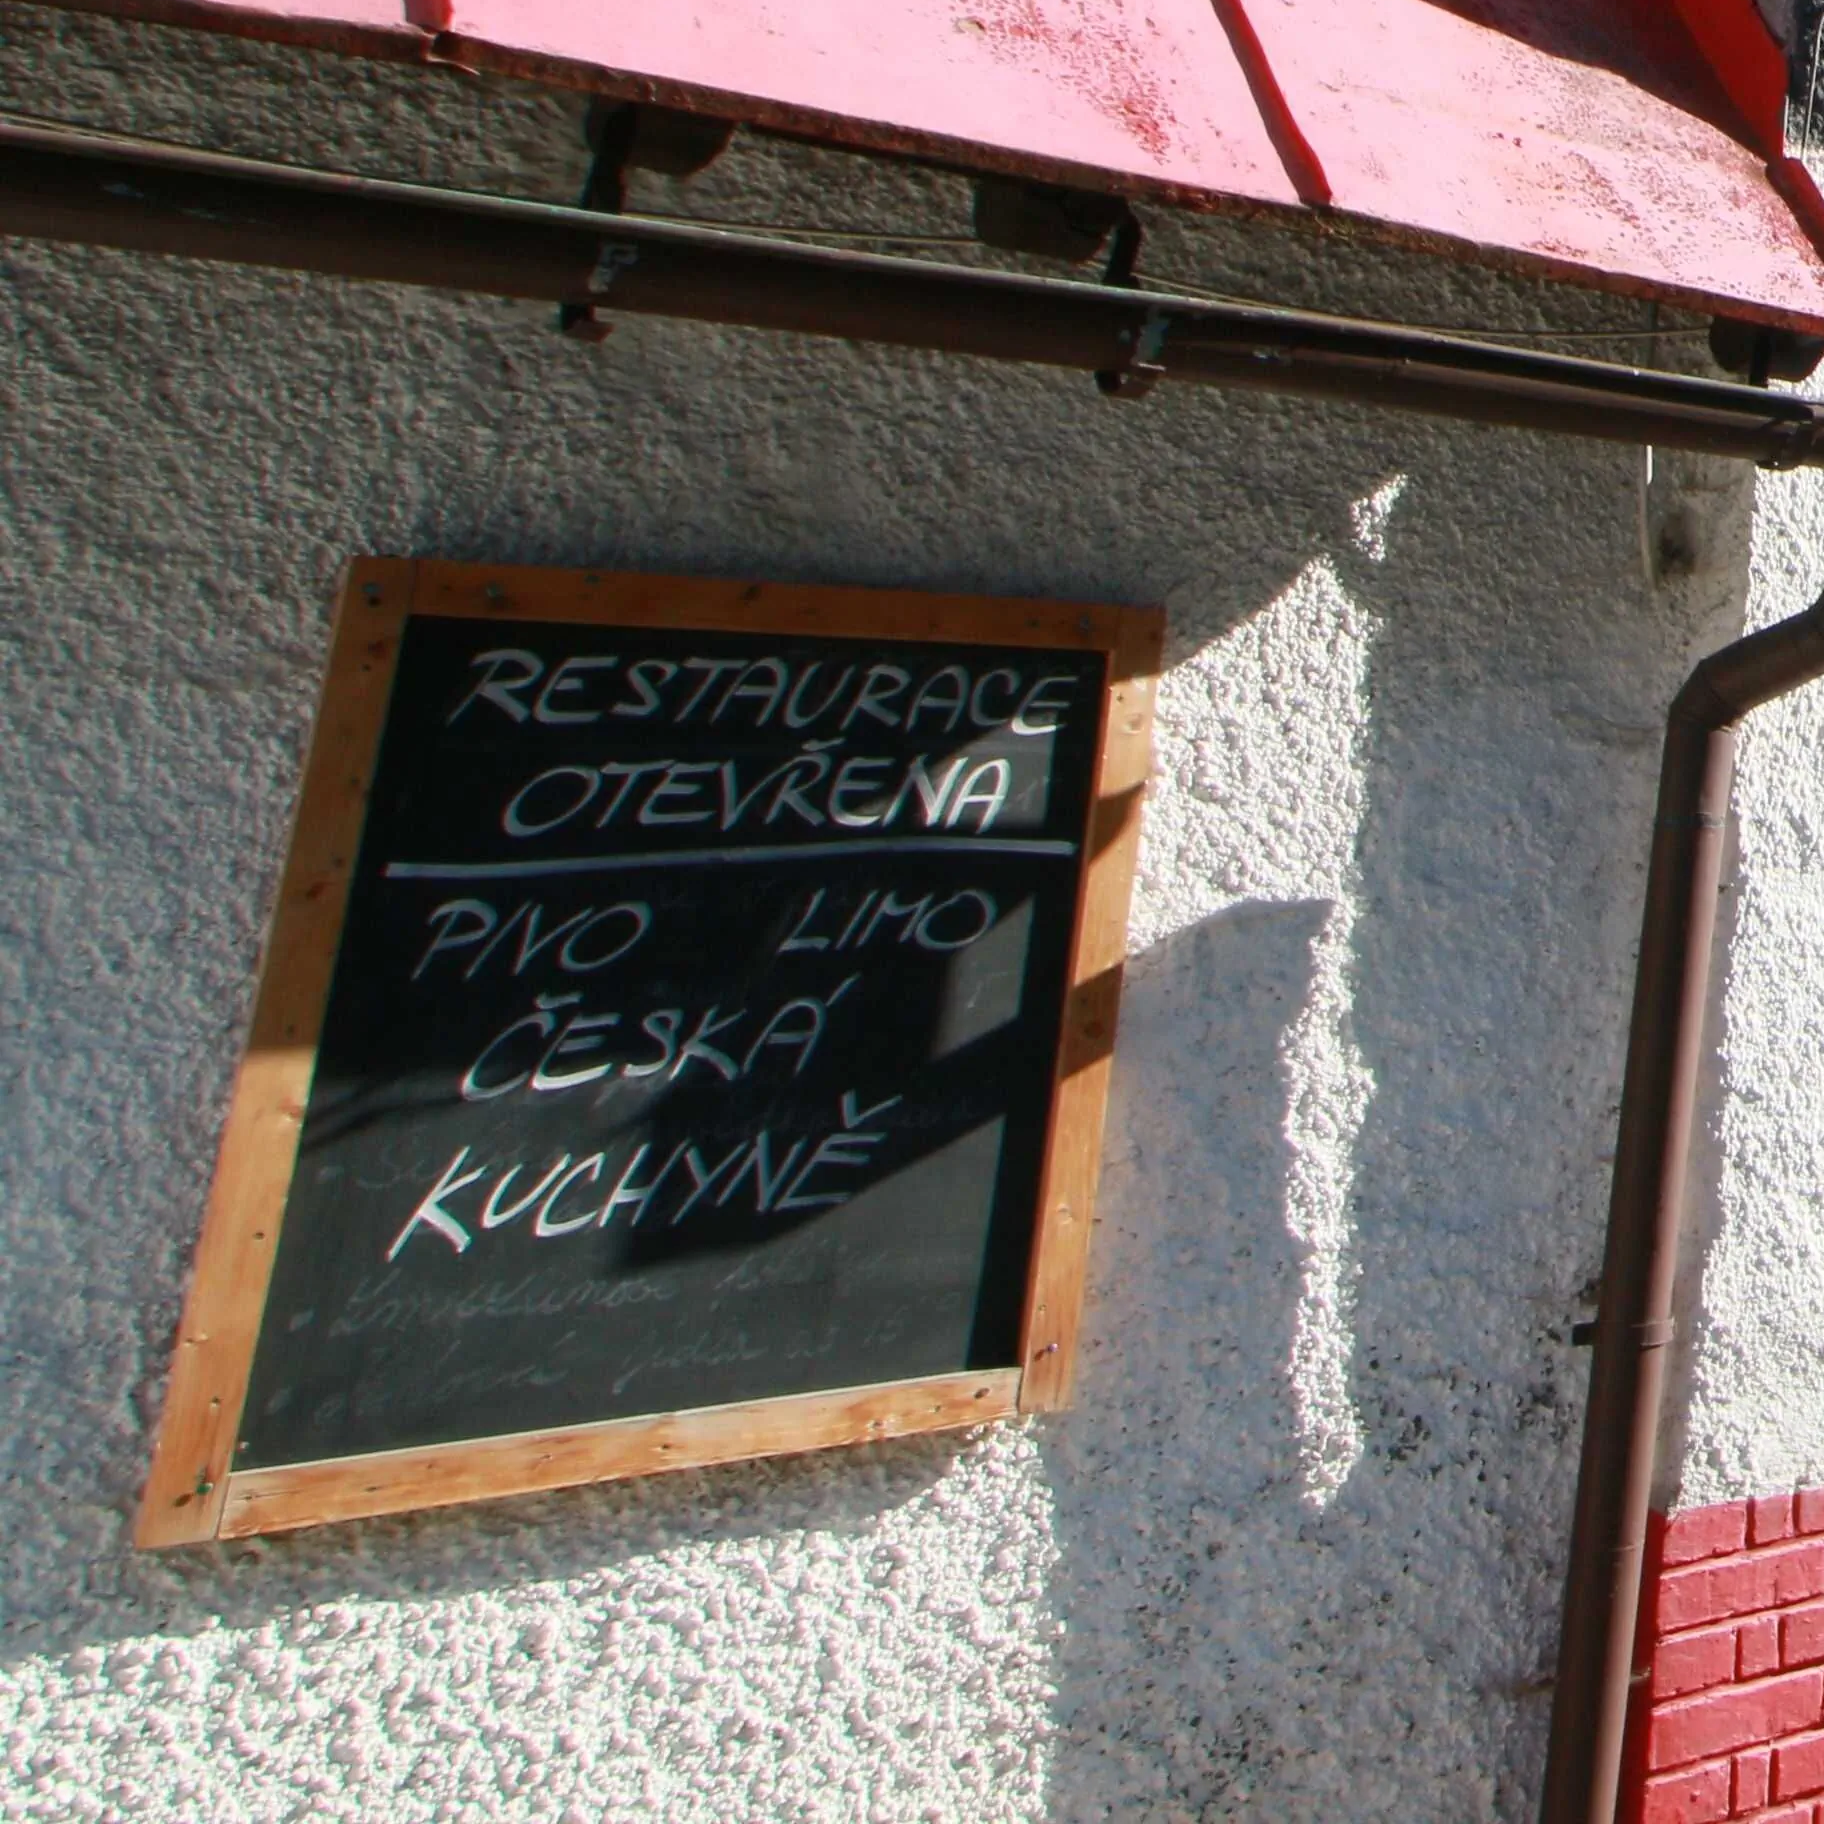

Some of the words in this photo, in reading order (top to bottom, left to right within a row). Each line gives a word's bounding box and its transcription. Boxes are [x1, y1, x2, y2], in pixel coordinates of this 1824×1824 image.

[446, 649, 1077, 736] RESTAURACE
[503, 737, 1011, 837] OTEVŘENA
[412, 897, 652, 982] PIVO
[779, 887, 999, 954] LIMO
[460, 973, 858, 1102] ČESKÁ
[385, 1089, 904, 1263] KUCHYNĚ
